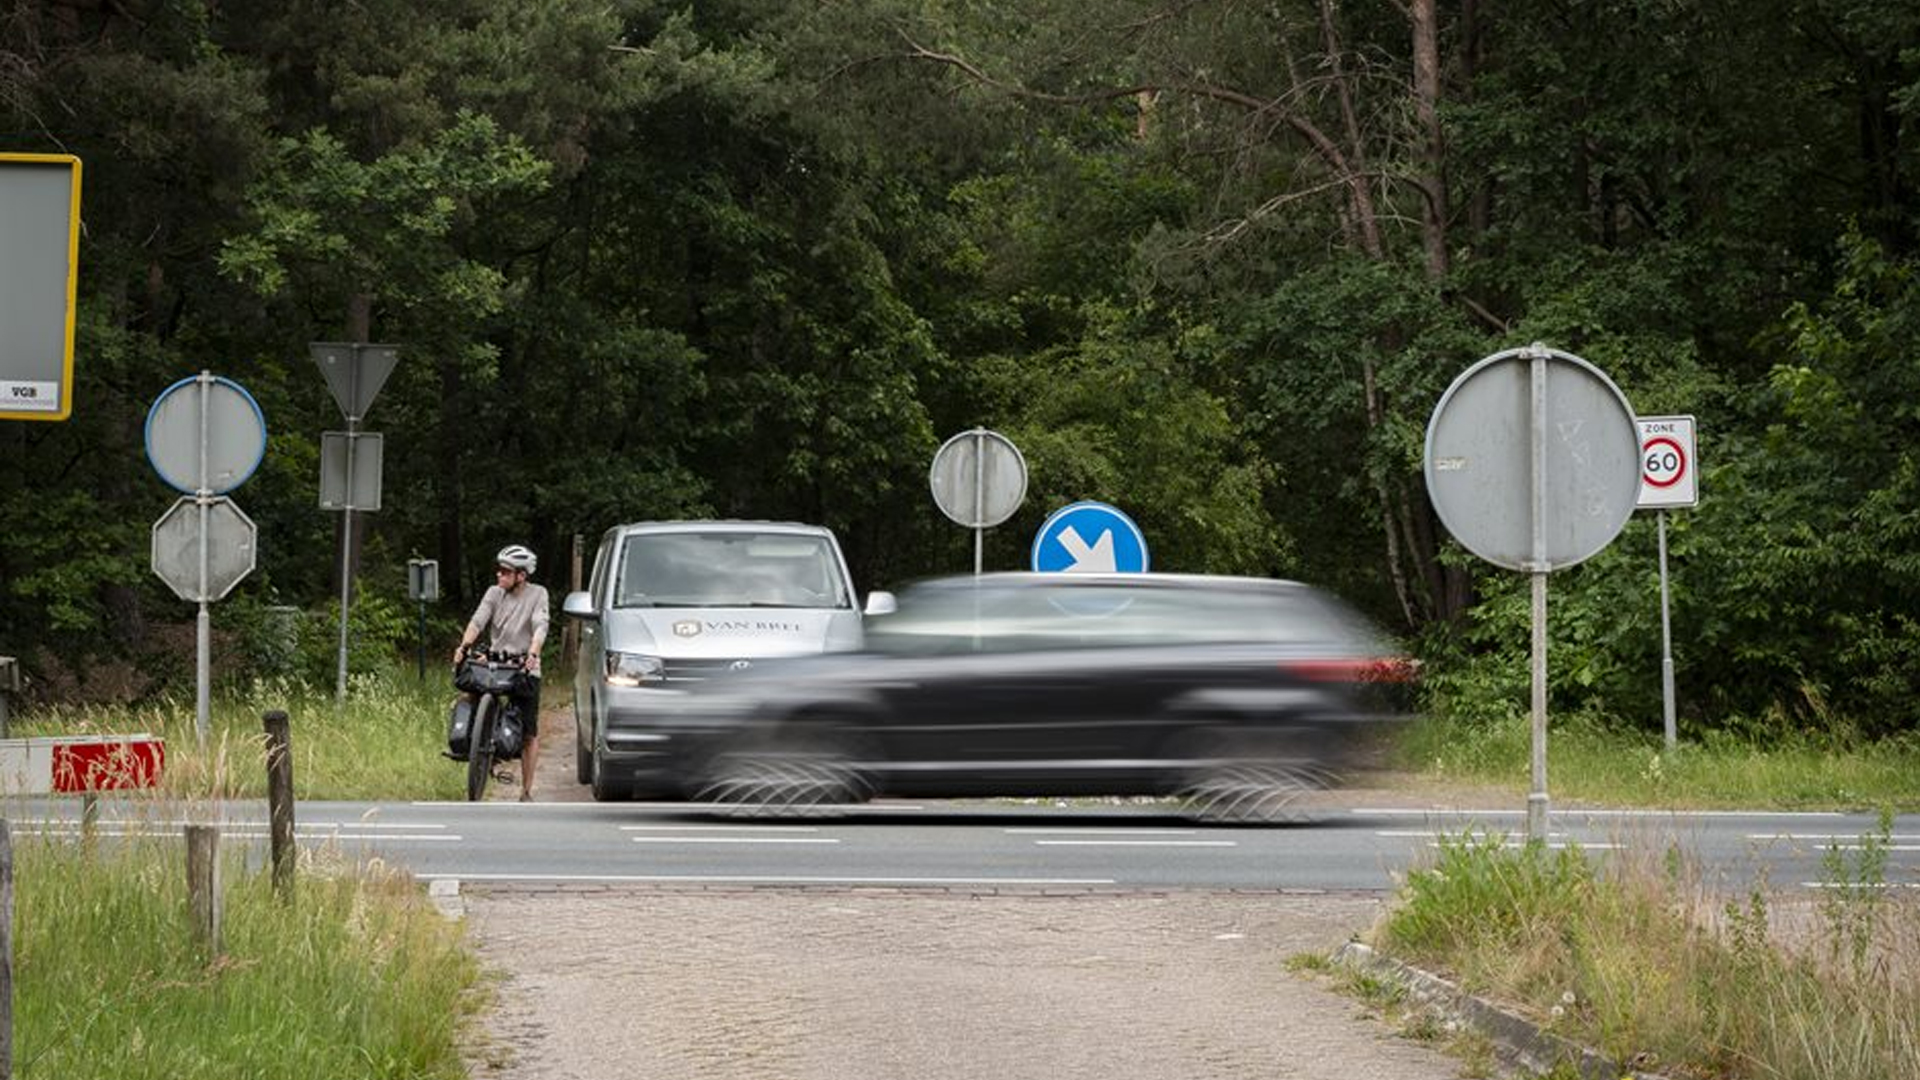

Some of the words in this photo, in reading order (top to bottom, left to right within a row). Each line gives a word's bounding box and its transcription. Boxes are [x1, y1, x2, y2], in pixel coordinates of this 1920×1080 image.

[1645, 424, 1674, 433] ZONE
[1646, 452, 1678, 472] 60
[706, 621, 750, 630] VAN
